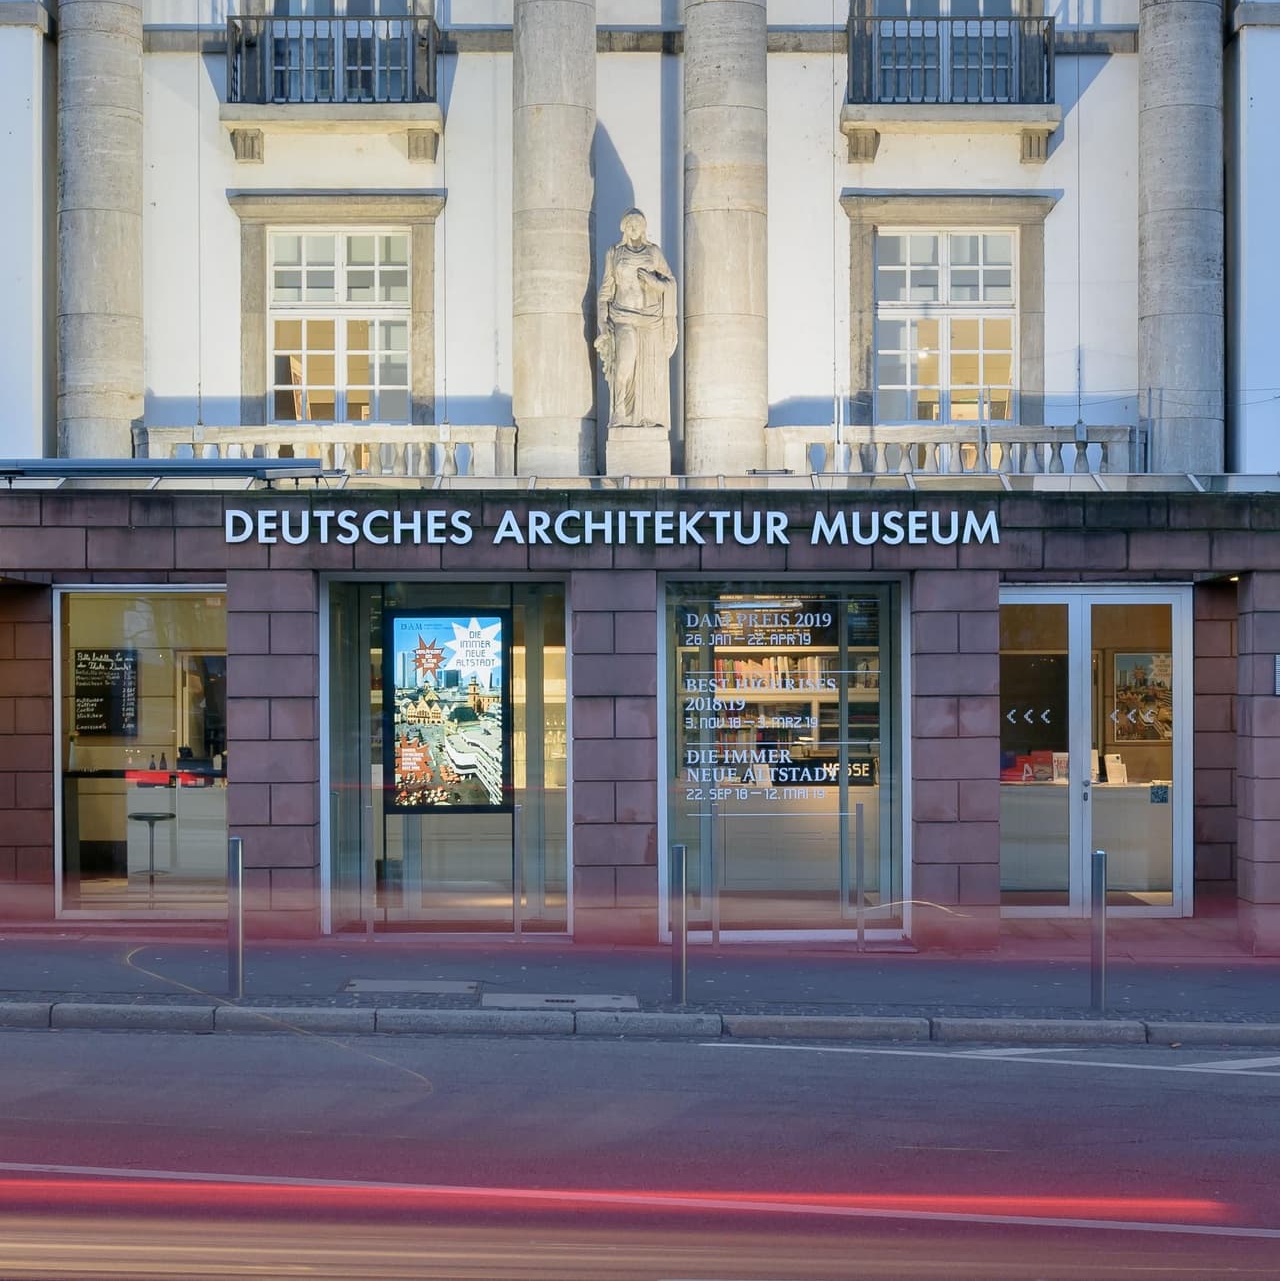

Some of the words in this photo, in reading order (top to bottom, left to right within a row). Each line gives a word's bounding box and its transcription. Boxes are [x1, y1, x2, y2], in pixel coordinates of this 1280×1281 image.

[224, 509, 474, 545] DEUTSCHES
[492, 509, 790, 545] ARCHITEKTUR
[810, 510, 1001, 545] MUSEUM
[686, 613, 732, 628] DAM
[736, 613, 790, 628] PREIS
[794, 612, 832, 628] 2019
[400, 623, 423, 631] DAM
[469, 630, 482, 639] DIE
[685, 634, 705, 646] 26.
[708, 634, 732, 646] JAN
[770, 634, 794, 645] APR
[460, 640, 491, 649] IMMER
[465, 649, 486, 658] NEUE
[455, 658, 496, 667] ALTSTADT
[685, 678, 730, 693] BEST
[735, 678, 837, 693] HIGHRISES
[685, 718, 697, 729] 3.
[699, 717, 725, 729] NOV
[727, 717, 742, 728] 18
[686, 749, 718, 764] DIE
[723, 749, 793, 764] IMMER
[686, 768, 737, 782] NEUE
[743, 767, 839, 782] ALTSTADT
[686, 789, 706, 800] 22.
[709, 789, 732, 800] SEP
[735, 788, 748, 800] 18
[764, 788, 781, 800] 12.
[783, 788, 809, 799] MAI
